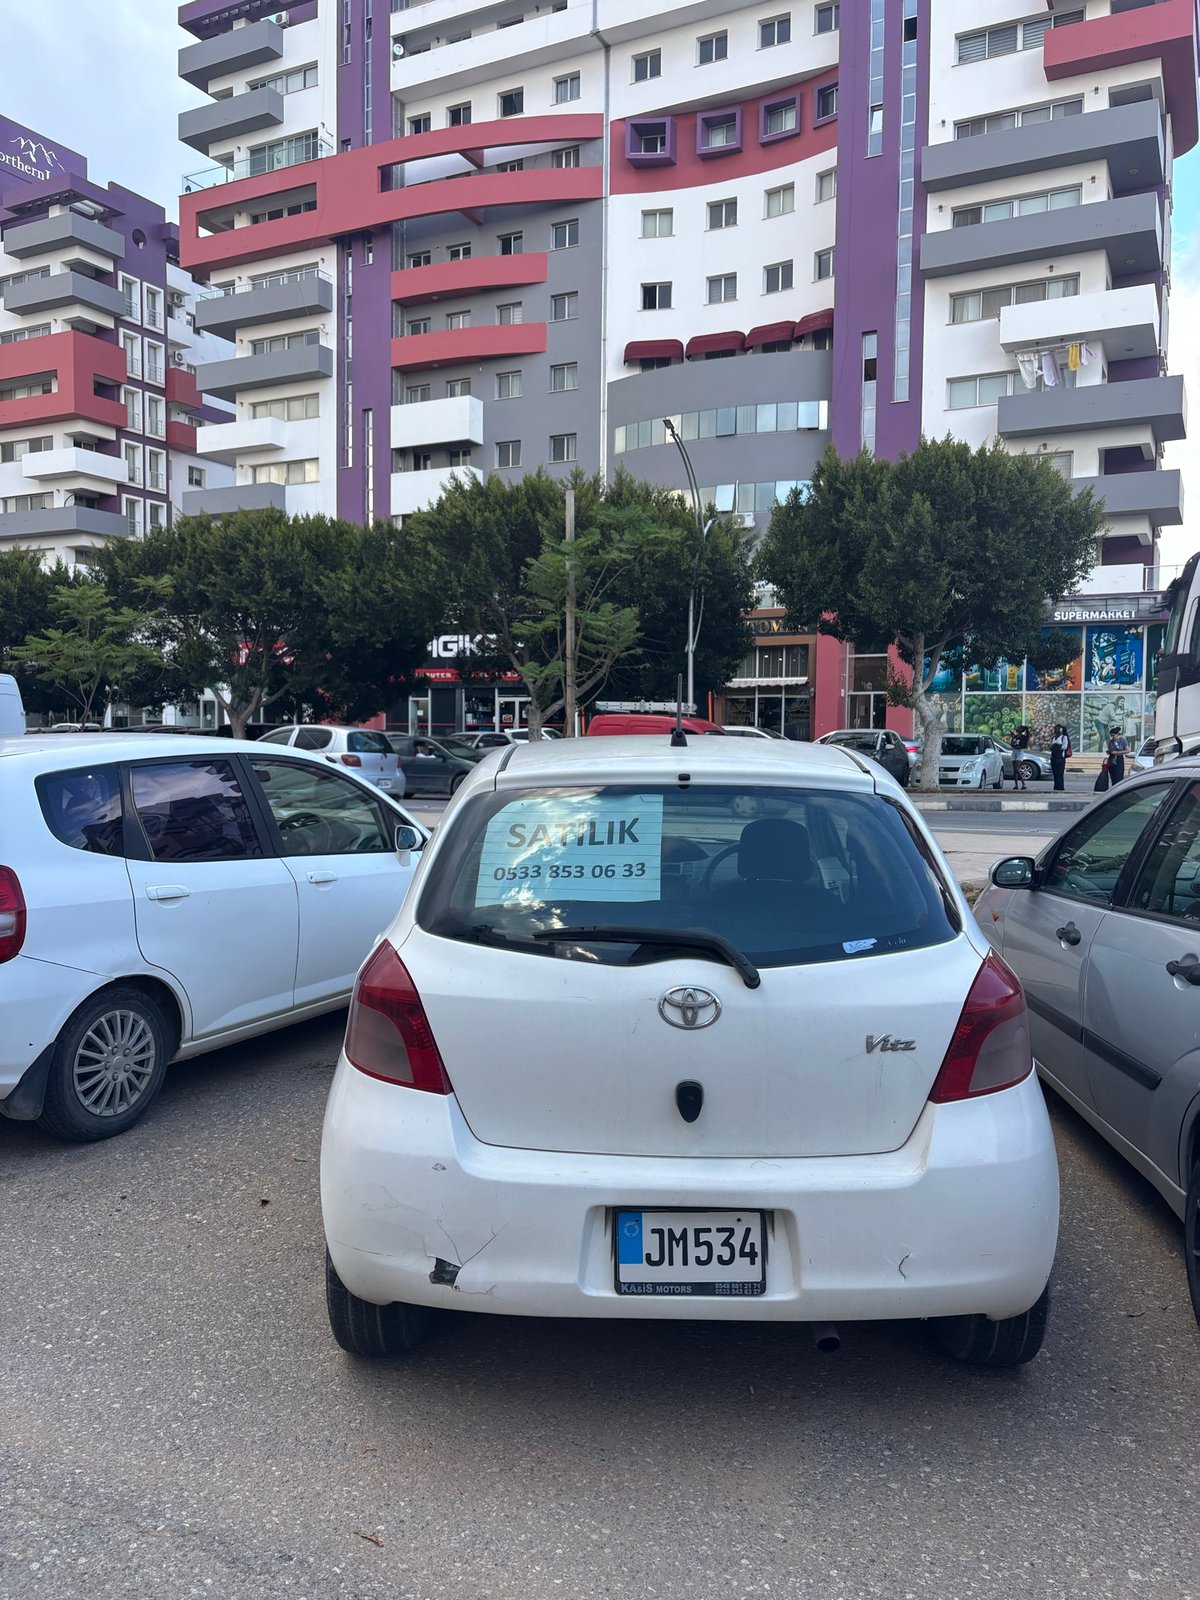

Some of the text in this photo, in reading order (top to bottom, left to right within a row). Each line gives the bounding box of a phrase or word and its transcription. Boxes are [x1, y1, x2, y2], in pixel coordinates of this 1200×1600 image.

[1054, 610, 1136, 621] SUPERMARKET
[507, 818, 640, 848] SATILIK
[493, 862, 646, 881] 0533 853 06 33
[866, 1033, 917, 1054] Vitz
[645, 1227, 758, 1267] JM534
[656, 1285, 692, 1294] MOTORS
